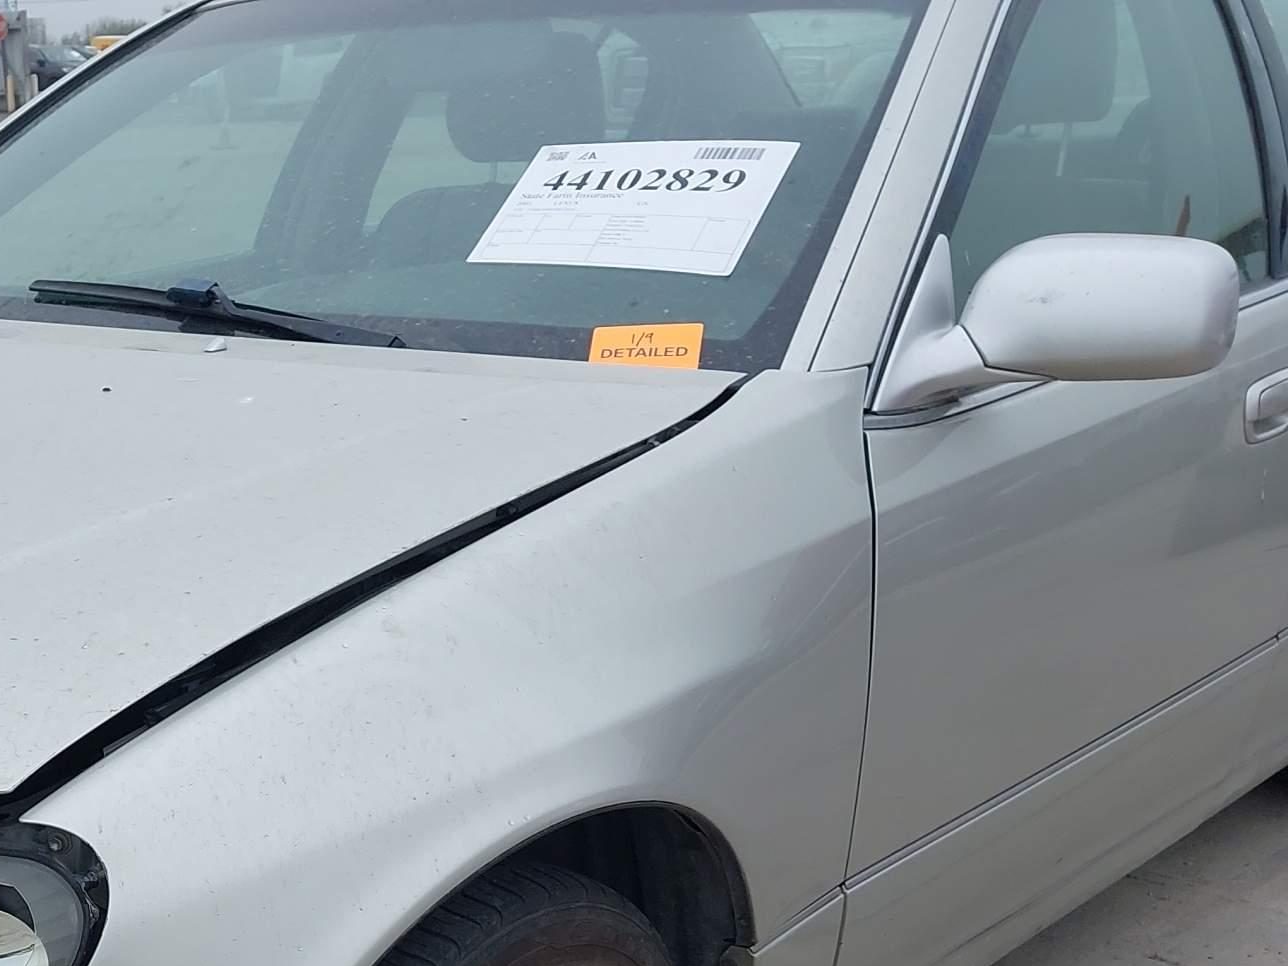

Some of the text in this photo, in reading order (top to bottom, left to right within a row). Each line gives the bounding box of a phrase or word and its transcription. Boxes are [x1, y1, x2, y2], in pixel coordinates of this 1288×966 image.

[543, 168, 747, 192] 44102829
[631, 332, 654, 347] 1/9
[600, 346, 689, 359] DETAILED
